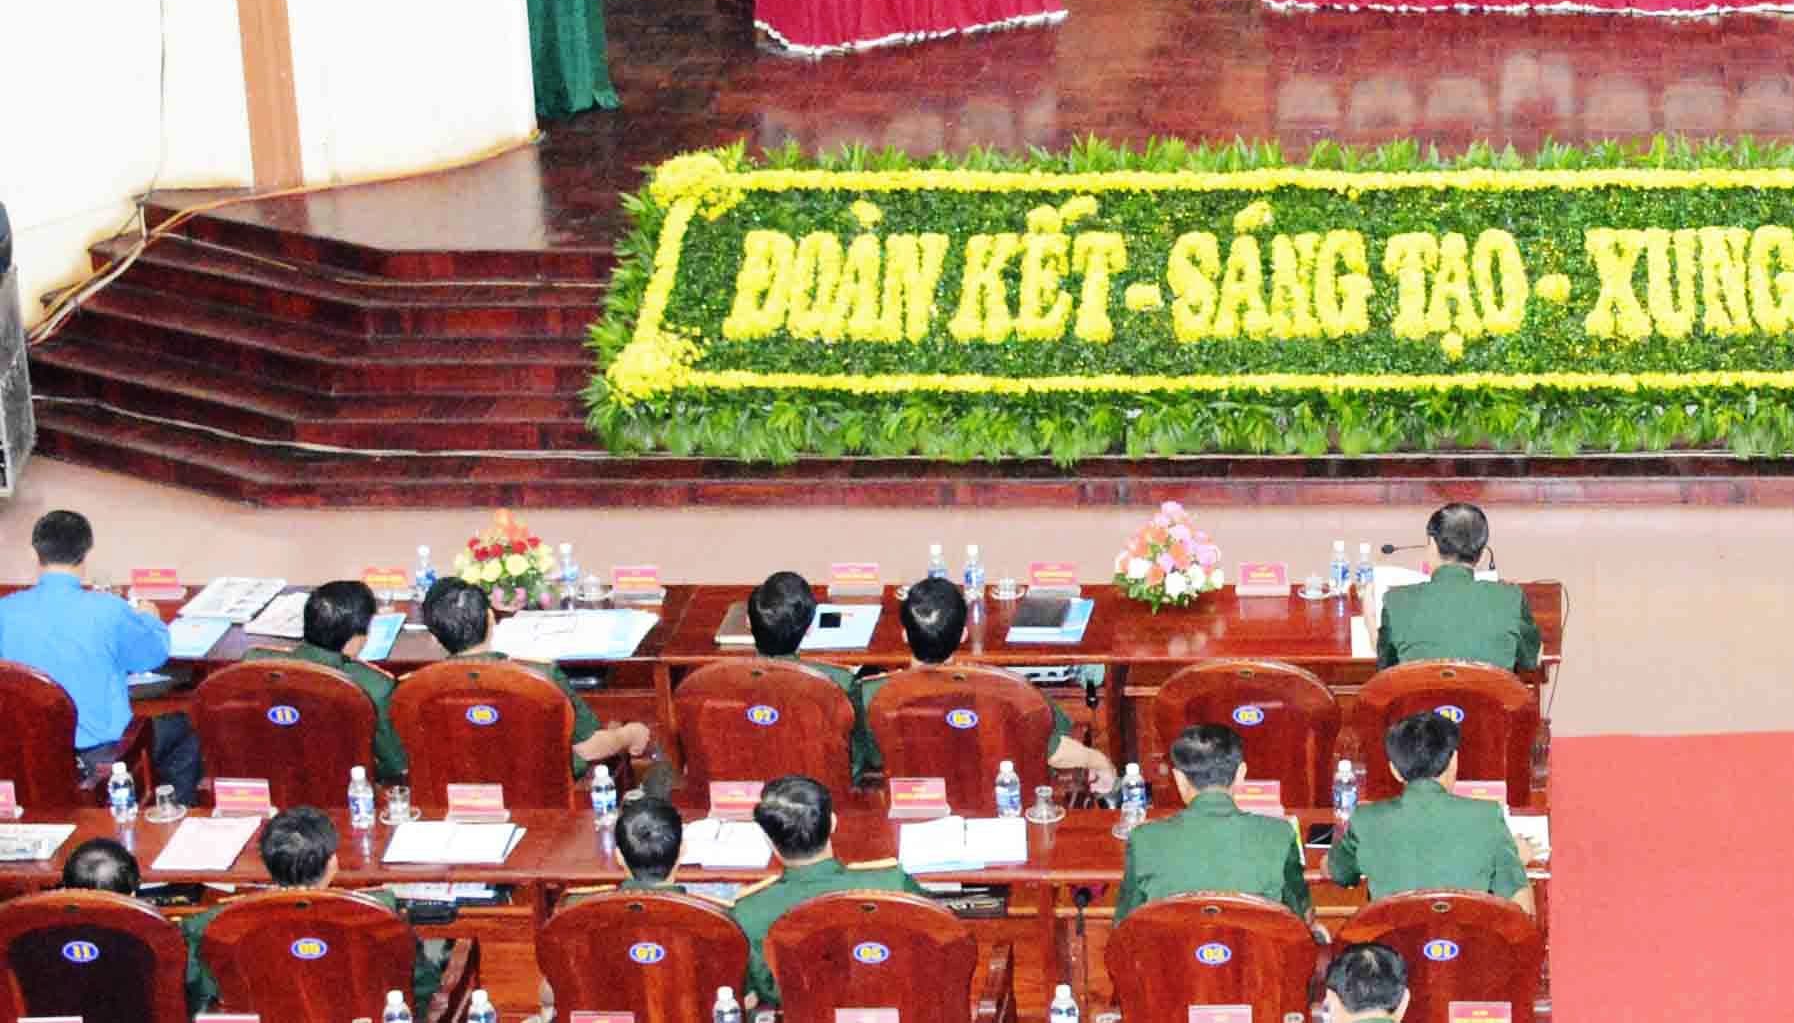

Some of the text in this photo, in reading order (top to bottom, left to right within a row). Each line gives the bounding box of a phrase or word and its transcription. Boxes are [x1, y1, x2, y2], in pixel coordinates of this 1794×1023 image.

[722, 199, 950, 343] ĐOÀN
[948, 195, 1127, 343] KẾT
[1167, 200, 1372, 343] SÁNG
[1383, 227, 1529, 361] TẠO
